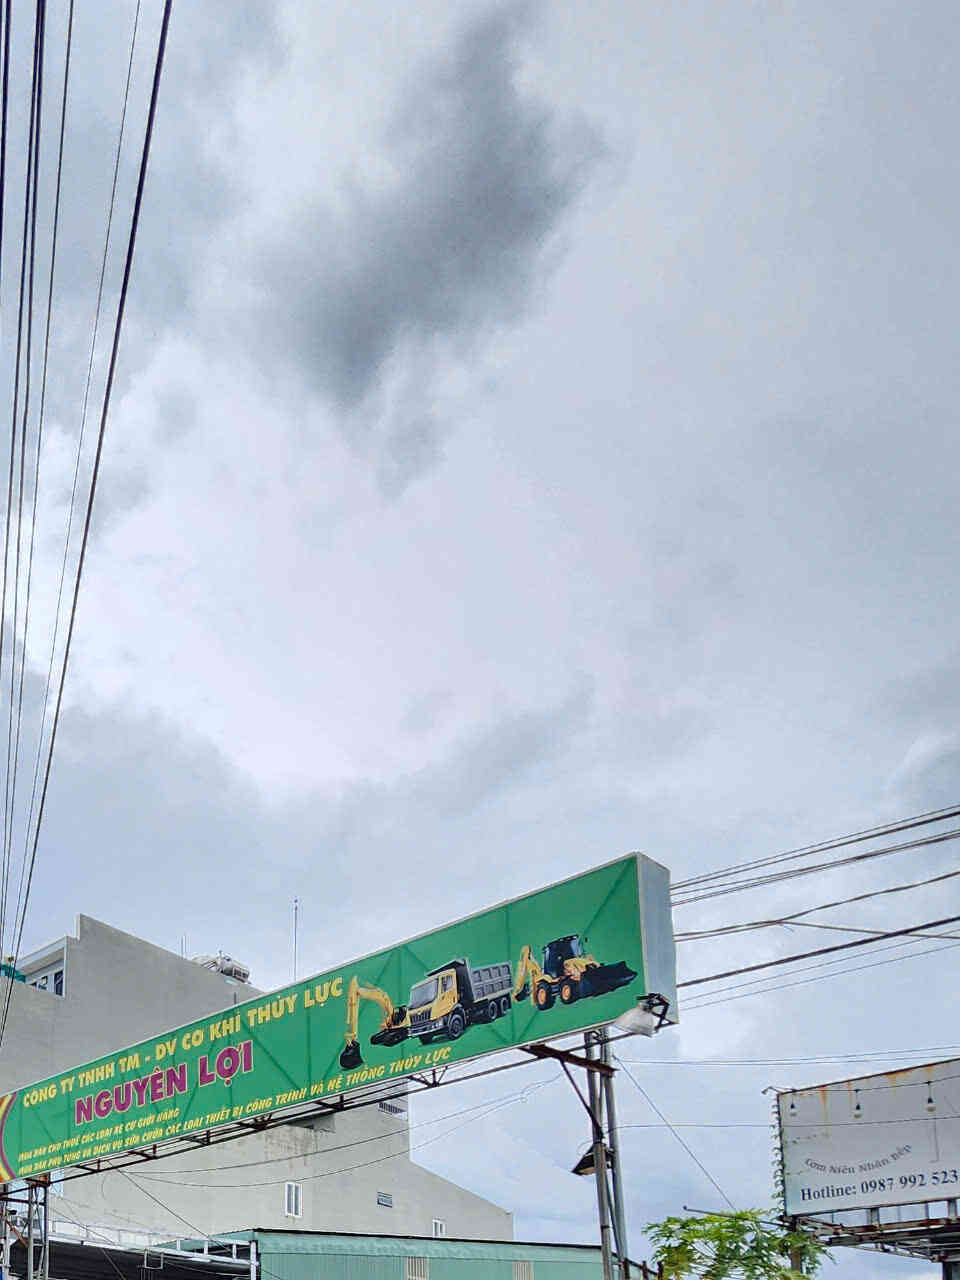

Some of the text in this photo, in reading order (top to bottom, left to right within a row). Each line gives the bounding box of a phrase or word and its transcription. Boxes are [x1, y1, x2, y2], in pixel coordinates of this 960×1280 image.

[23, 1084, 57, 1107] CÔNG
[61, 1076, 74, 1095] TY
[78, 1061, 115, 1088] TNHH
[118, 1053, 140, 1072] TM
[156, 1037, 177, 1060] DV
[209, 1010, 240, 1040] KHÍ
[247, 995, 298, 1027] THỦY
[304, 977, 343, 1008] LỰC
[74, 1040, 253, 1126] NGUYÊN LỢI
[232, 1102, 243, 1119] BỊ
[246, 1094, 273, 1113] CÔNG
[310, 1079, 324, 1094] VÀ
[327, 1073, 342, 1093] HỆ
[345, 1064, 385, 1087] THỐNG
[425, 1046, 452, 1066] LỰC
[800, 1169, 959, 1201] Hotline: 0987 992 523
